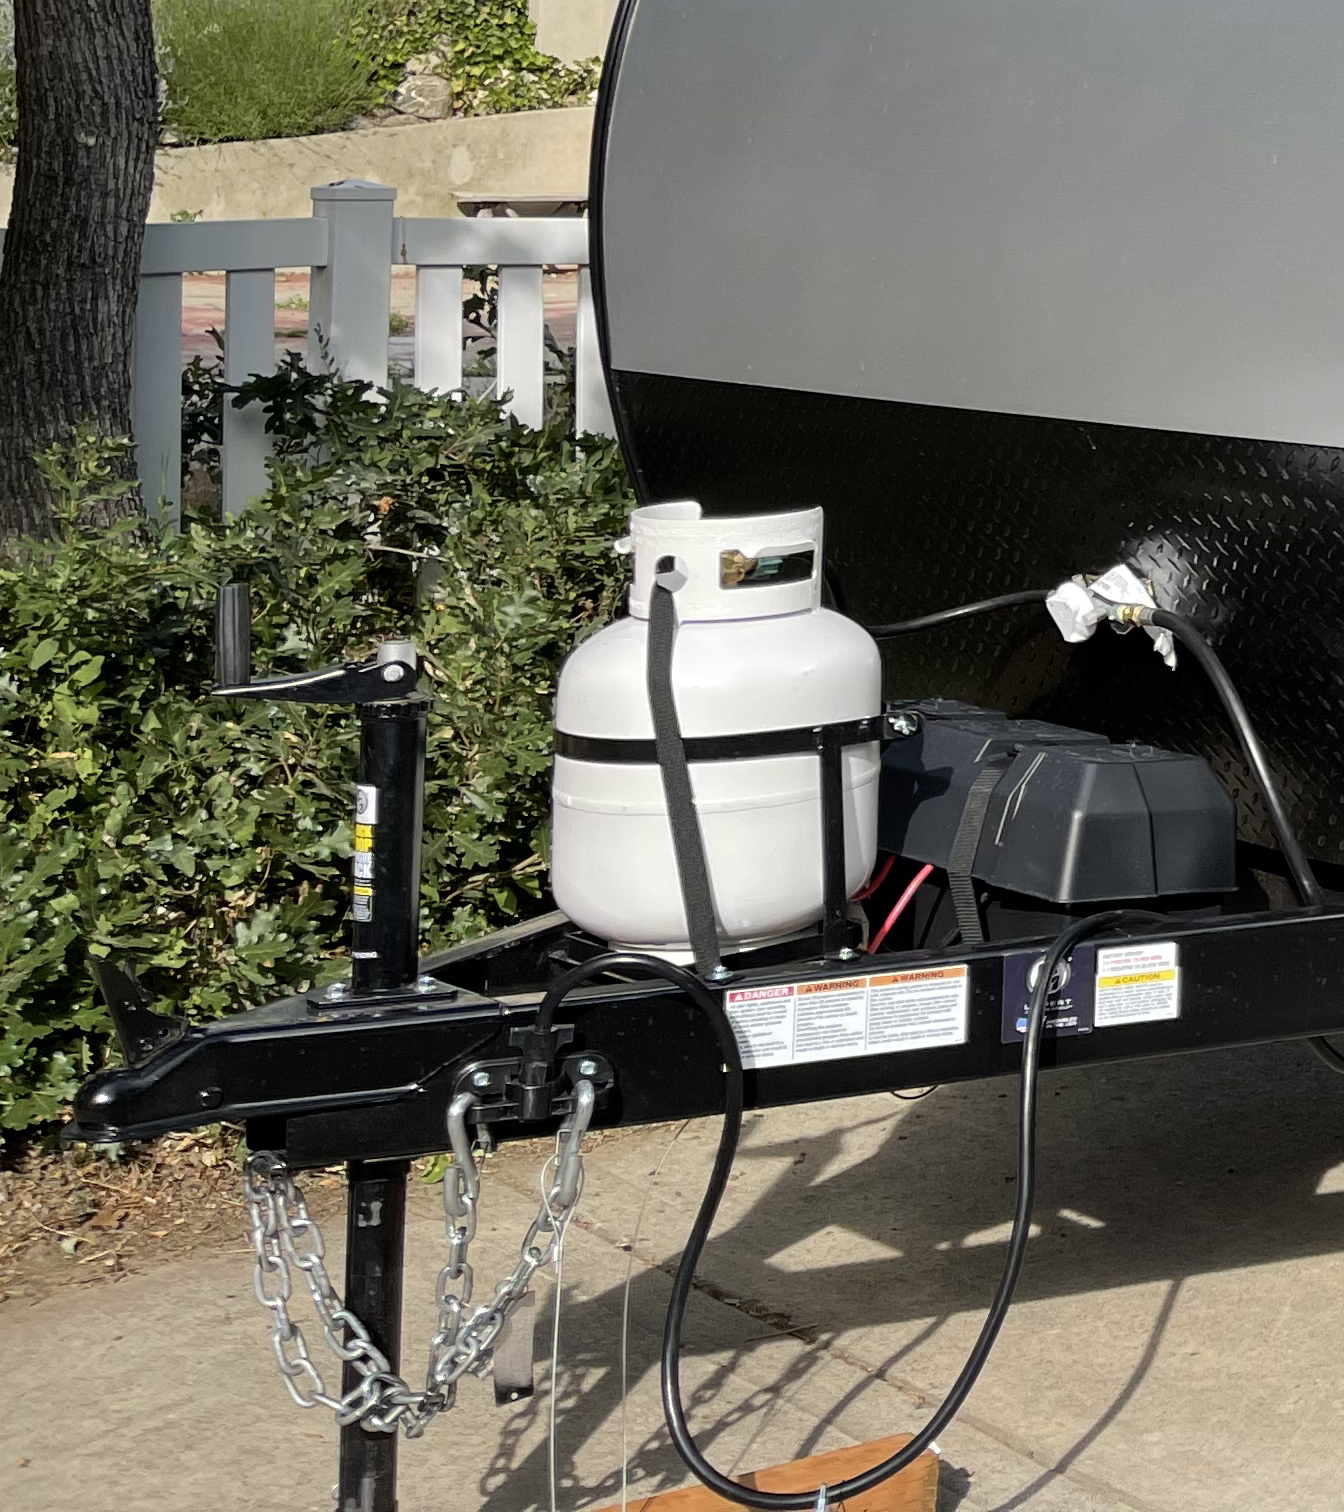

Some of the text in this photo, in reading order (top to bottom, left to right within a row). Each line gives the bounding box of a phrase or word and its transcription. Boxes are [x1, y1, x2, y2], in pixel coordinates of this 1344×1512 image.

[901, 971, 944, 982] WARNING
[1122, 973, 1160, 984] CAUTION
[813, 979, 859, 992] WARNING
[744, 987, 789, 1000] DANGER
